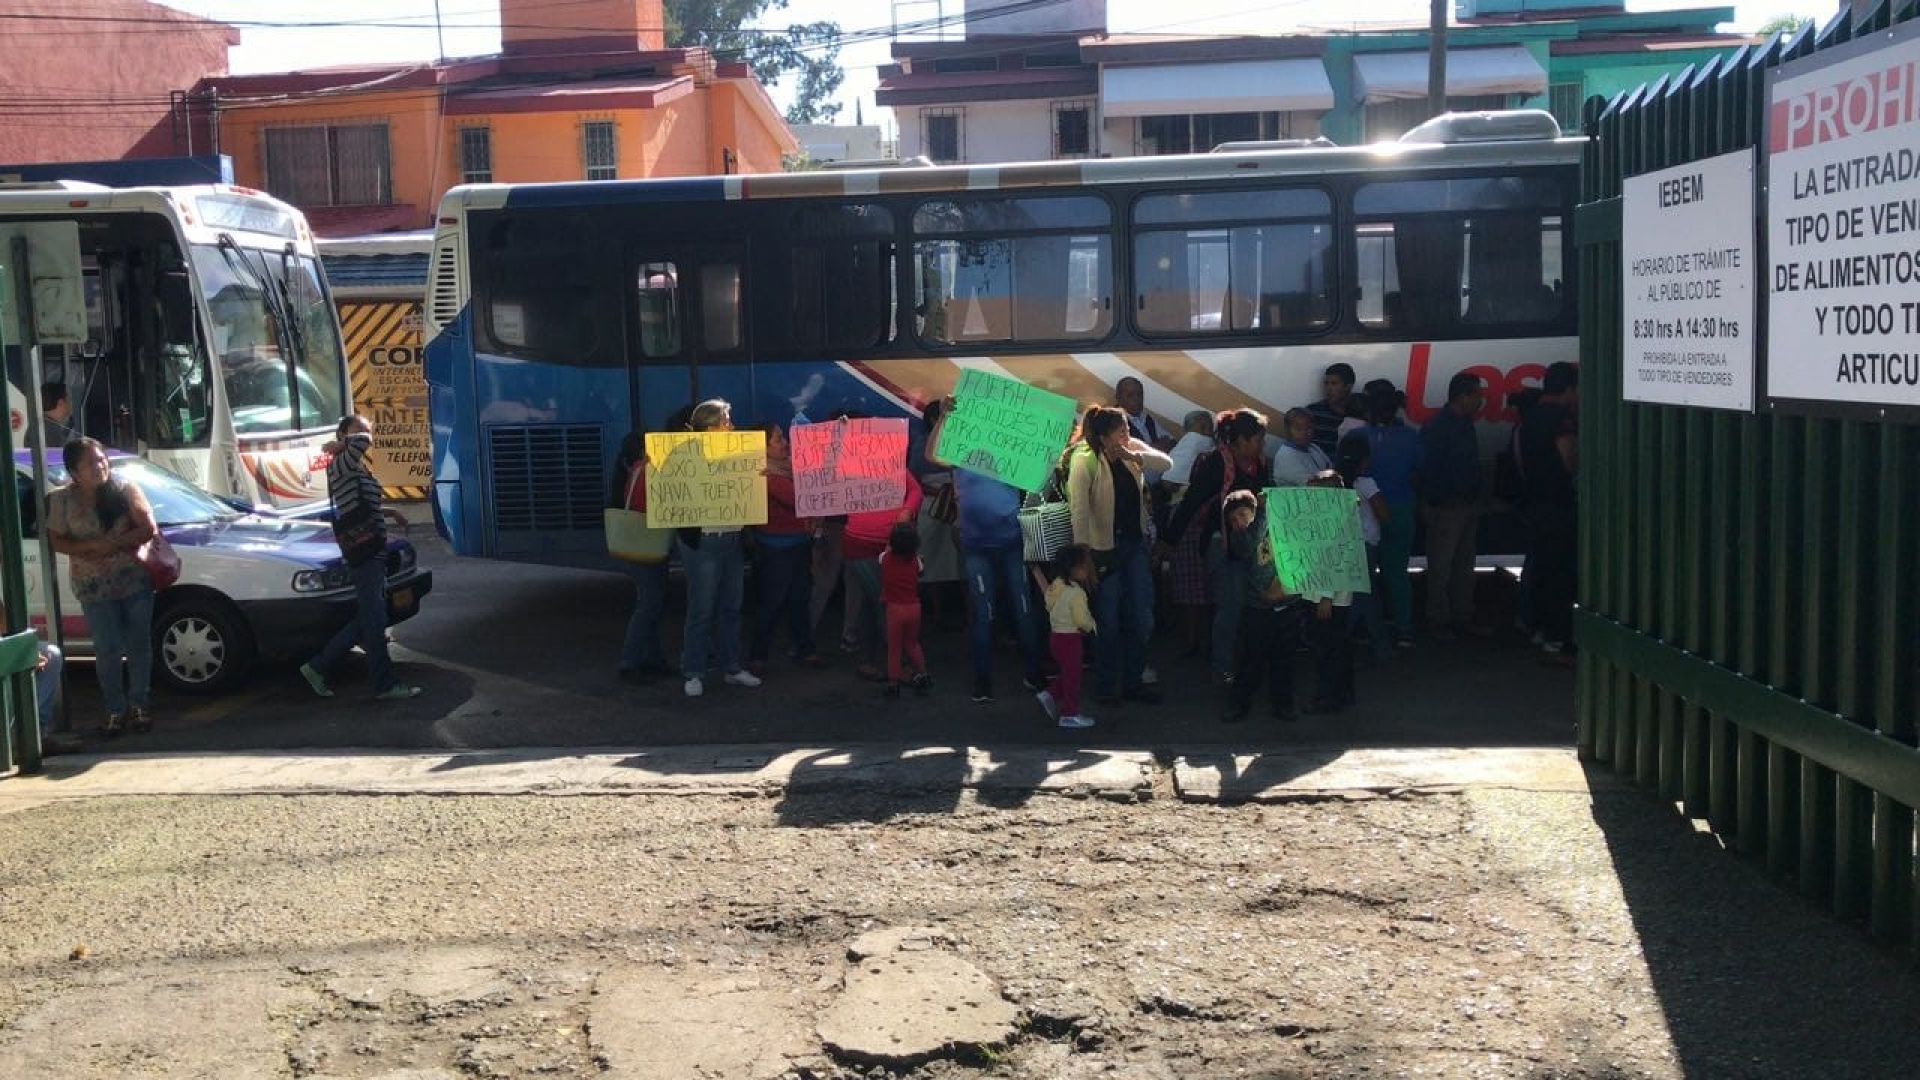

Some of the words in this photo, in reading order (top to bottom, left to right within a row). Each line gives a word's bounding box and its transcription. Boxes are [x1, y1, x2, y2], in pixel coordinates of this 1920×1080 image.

[1659, 173, 1703, 208] IEBEM
[1794, 168, 1818, 200] LA
[1785, 213, 1829, 246] TIPO
[1836, 207, 1863, 240] DE
[1871, 198, 1920, 235] VEN
[1632, 256, 1674, 277] HORARIO
[1677, 254, 1690, 274] DE
[1692, 247, 1740, 271] TRÁMITE
[1648, 284, 1659, 302] AL
[1707, 280, 1721, 299] DE
[1776, 263, 1799, 292] DE
[1633, 319, 1654, 339] 8:30
[1657, 318, 1673, 339] hrs
[1675, 318, 1684, 338] A
[1686, 317, 1716, 338] 14:30
[1720, 317, 1739, 338] hrs
[1815, 306, 1828, 336] Y
[1833, 303, 1893, 335] TODO
[1643, 352, 1677, 365] PROHIBIDA
[1678, 353, 1686, 365] LA
[1687, 352, 1719, 366] ENTRADA
[1836, 353, 1919, 386] ARTICU
[1638, 369, 1656, 381] TODO
[1657, 370, 1671, 382] TIPO
[1673, 371, 1682, 383] DE
[1684, 372, 1733, 386] VENDEDORES
[727, 433, 758, 453] DE
[650, 481, 693, 504] NAVA
